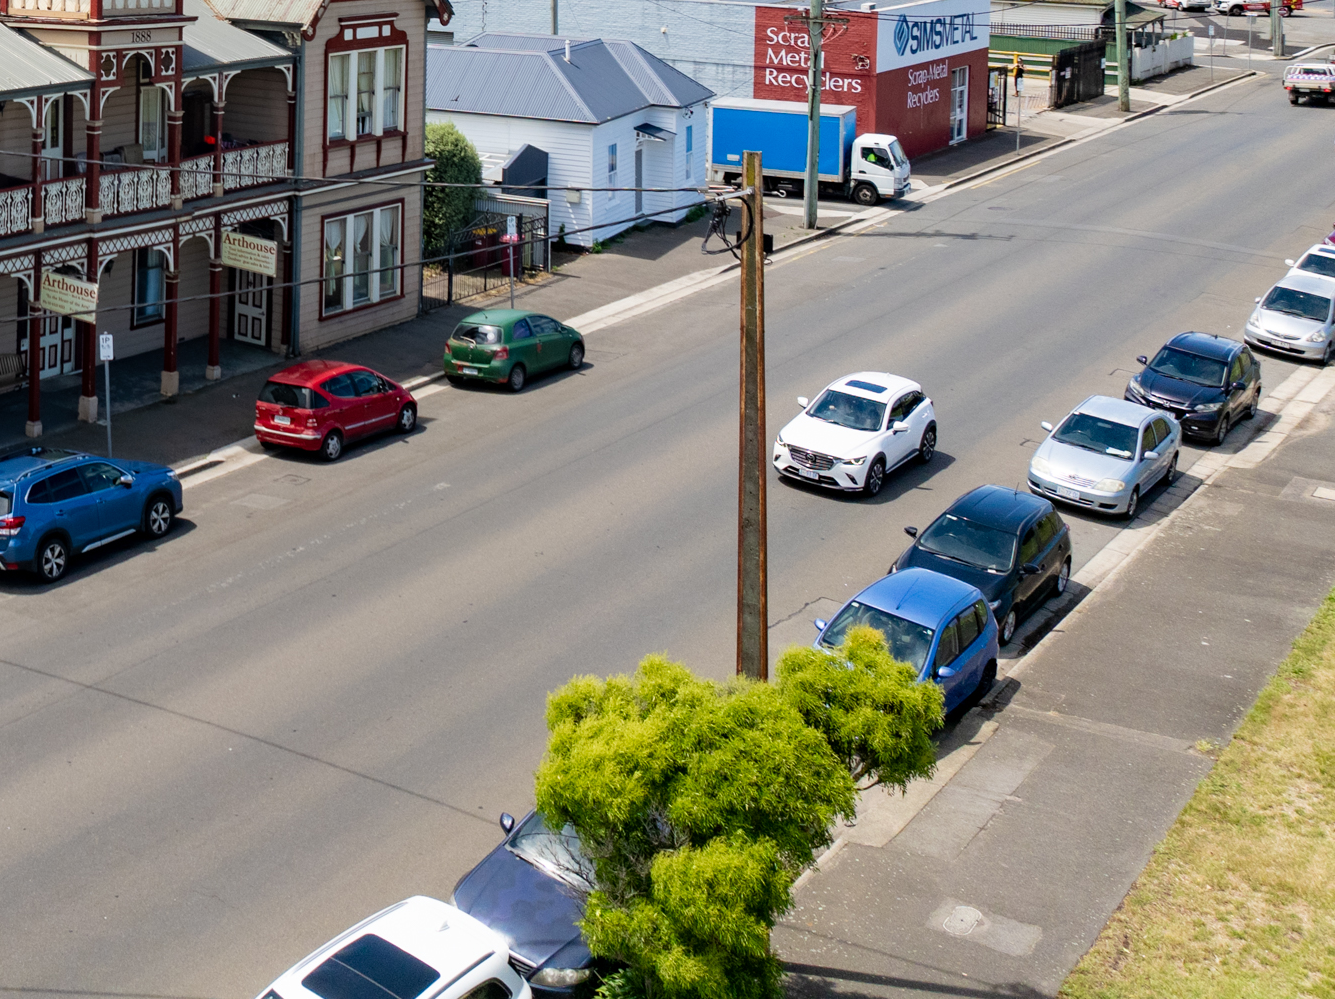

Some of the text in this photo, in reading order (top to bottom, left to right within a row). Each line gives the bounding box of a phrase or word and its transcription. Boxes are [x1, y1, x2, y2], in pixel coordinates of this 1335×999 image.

[131, 30, 152, 43] 1888
[766, 27, 823, 48] Scra
[910, 12, 978, 55] SIMSMETAL
[908, 59, 949, 88] Scrap Metal
[907, 85, 940, 109] Recyclers
[223, 233, 276, 255] Arthouse
[42, 273, 96, 299] Arthouse
[101, 336, 111, 344] 1P
